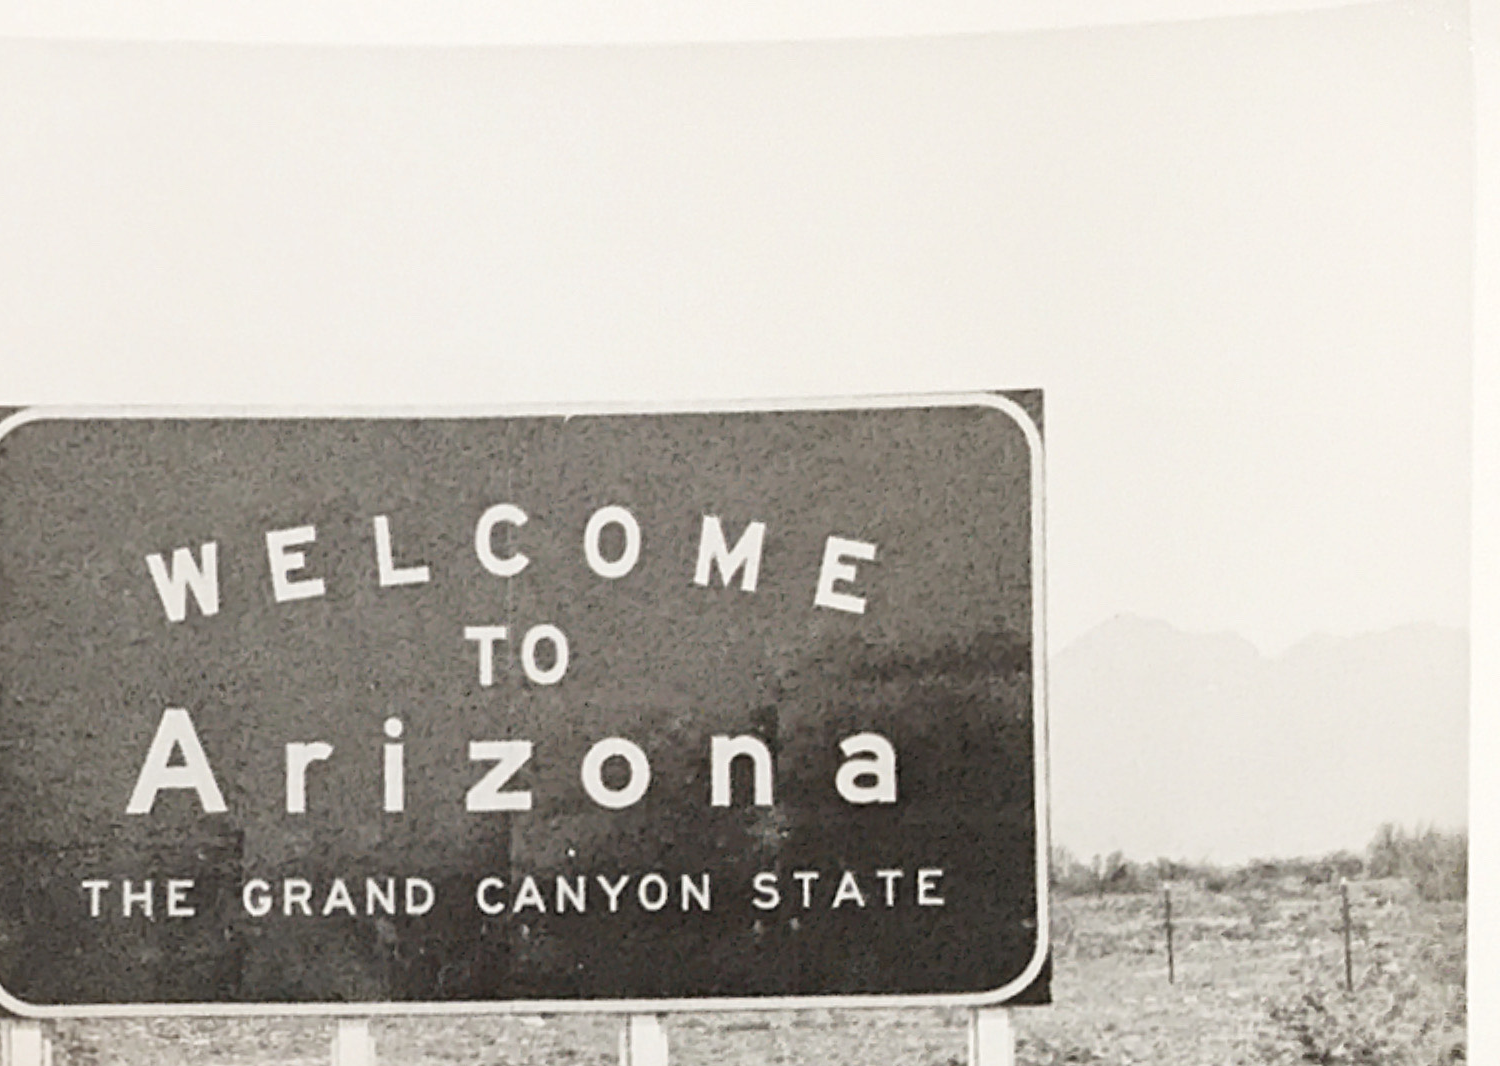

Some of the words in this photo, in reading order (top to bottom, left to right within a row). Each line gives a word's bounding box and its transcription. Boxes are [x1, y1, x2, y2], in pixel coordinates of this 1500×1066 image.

[146, 503, 878, 622] WELCOME
[463, 624, 570, 687] TO
[125, 707, 899, 816] Arizona
[81, 878, 197, 919] THE
[242, 876, 437, 919] GRAND
[475, 872, 715, 915] CANYON
[751, 869, 947, 911] STATE
